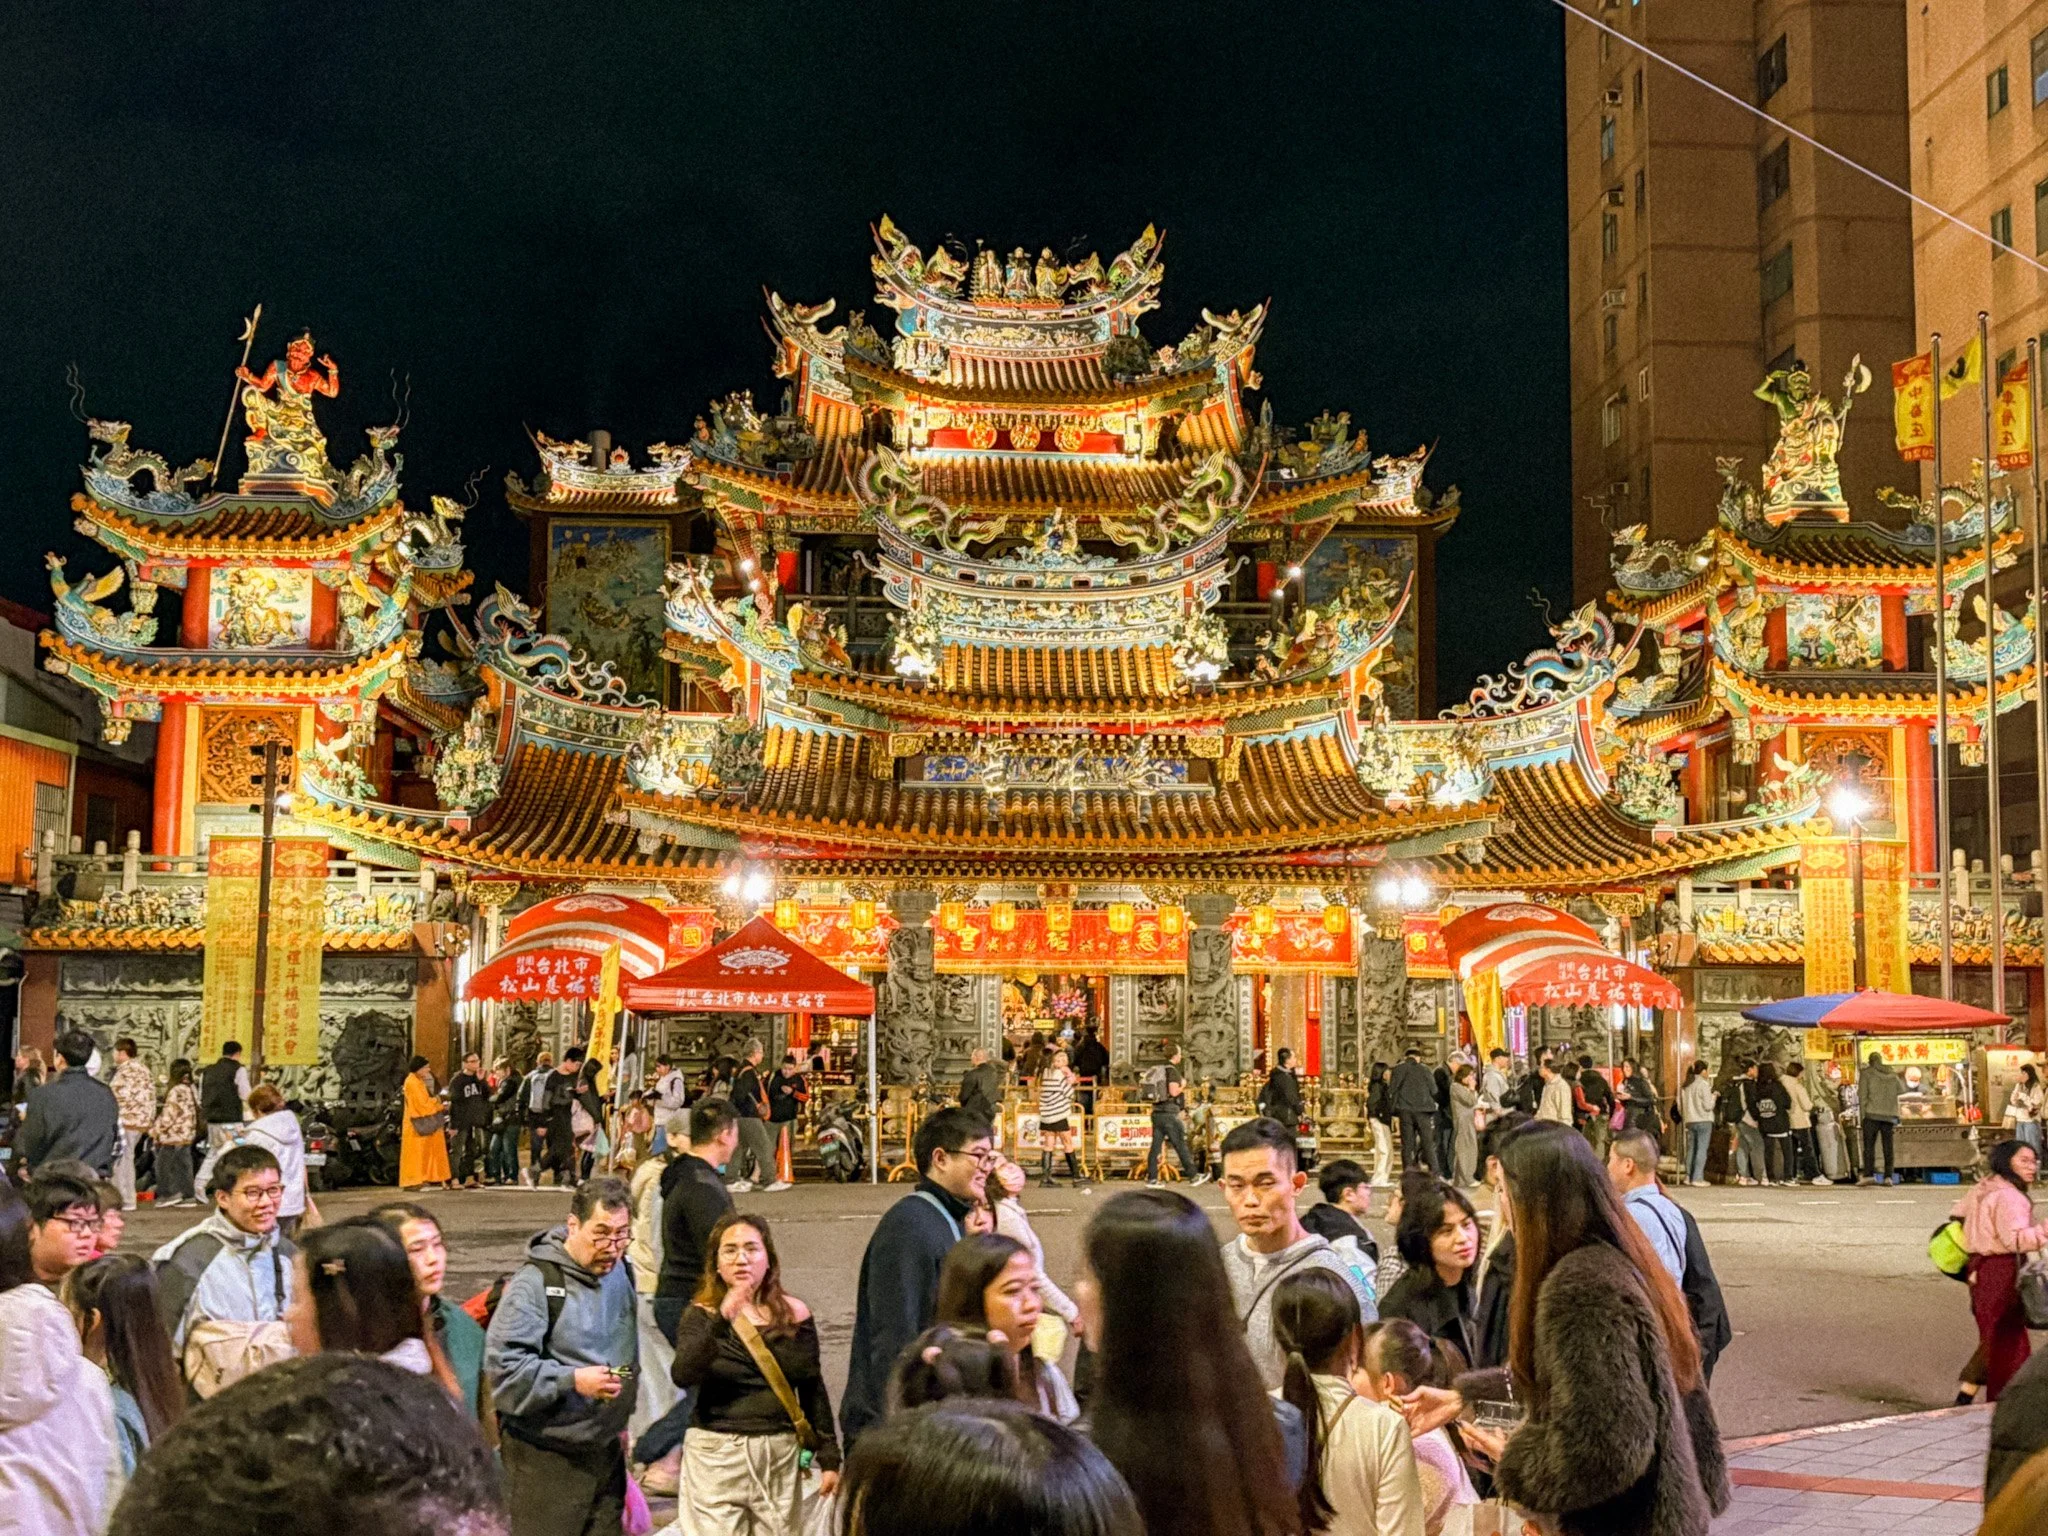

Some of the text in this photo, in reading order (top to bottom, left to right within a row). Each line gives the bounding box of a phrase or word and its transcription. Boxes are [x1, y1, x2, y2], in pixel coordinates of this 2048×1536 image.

[536, 956, 591, 975] 台北市
[1577, 963, 1628, 981] 台北市
[1543, 981, 1645, 1000] 松山慈祐宮
[463, 1083, 483, 1098] GA
